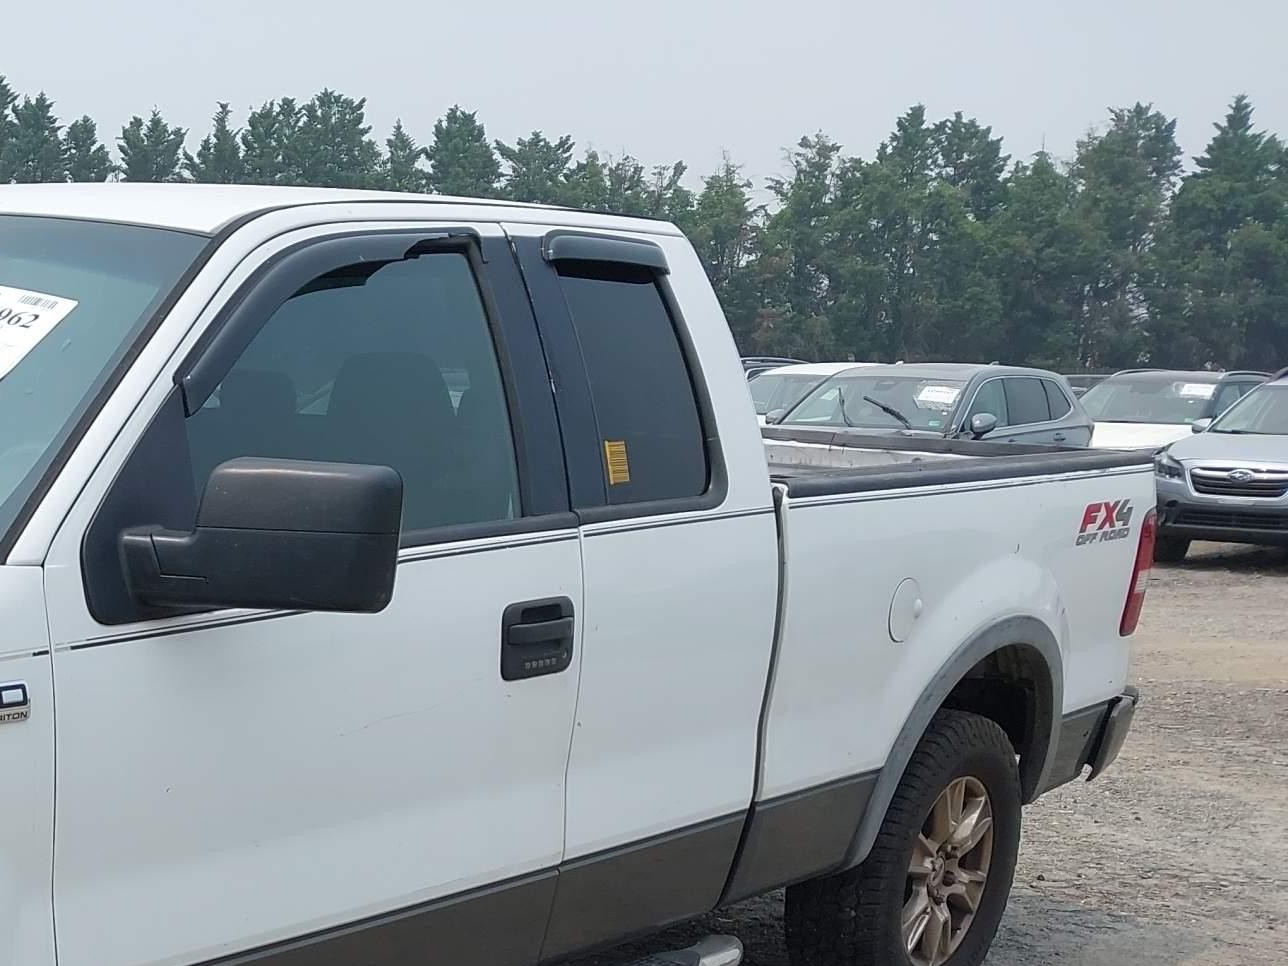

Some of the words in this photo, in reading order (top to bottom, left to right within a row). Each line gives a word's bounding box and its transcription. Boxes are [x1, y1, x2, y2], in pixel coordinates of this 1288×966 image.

[1078, 498, 1134, 534] FX4
[1075, 532, 1099, 546] OFF
[1099, 527, 1130, 543] ROAD
